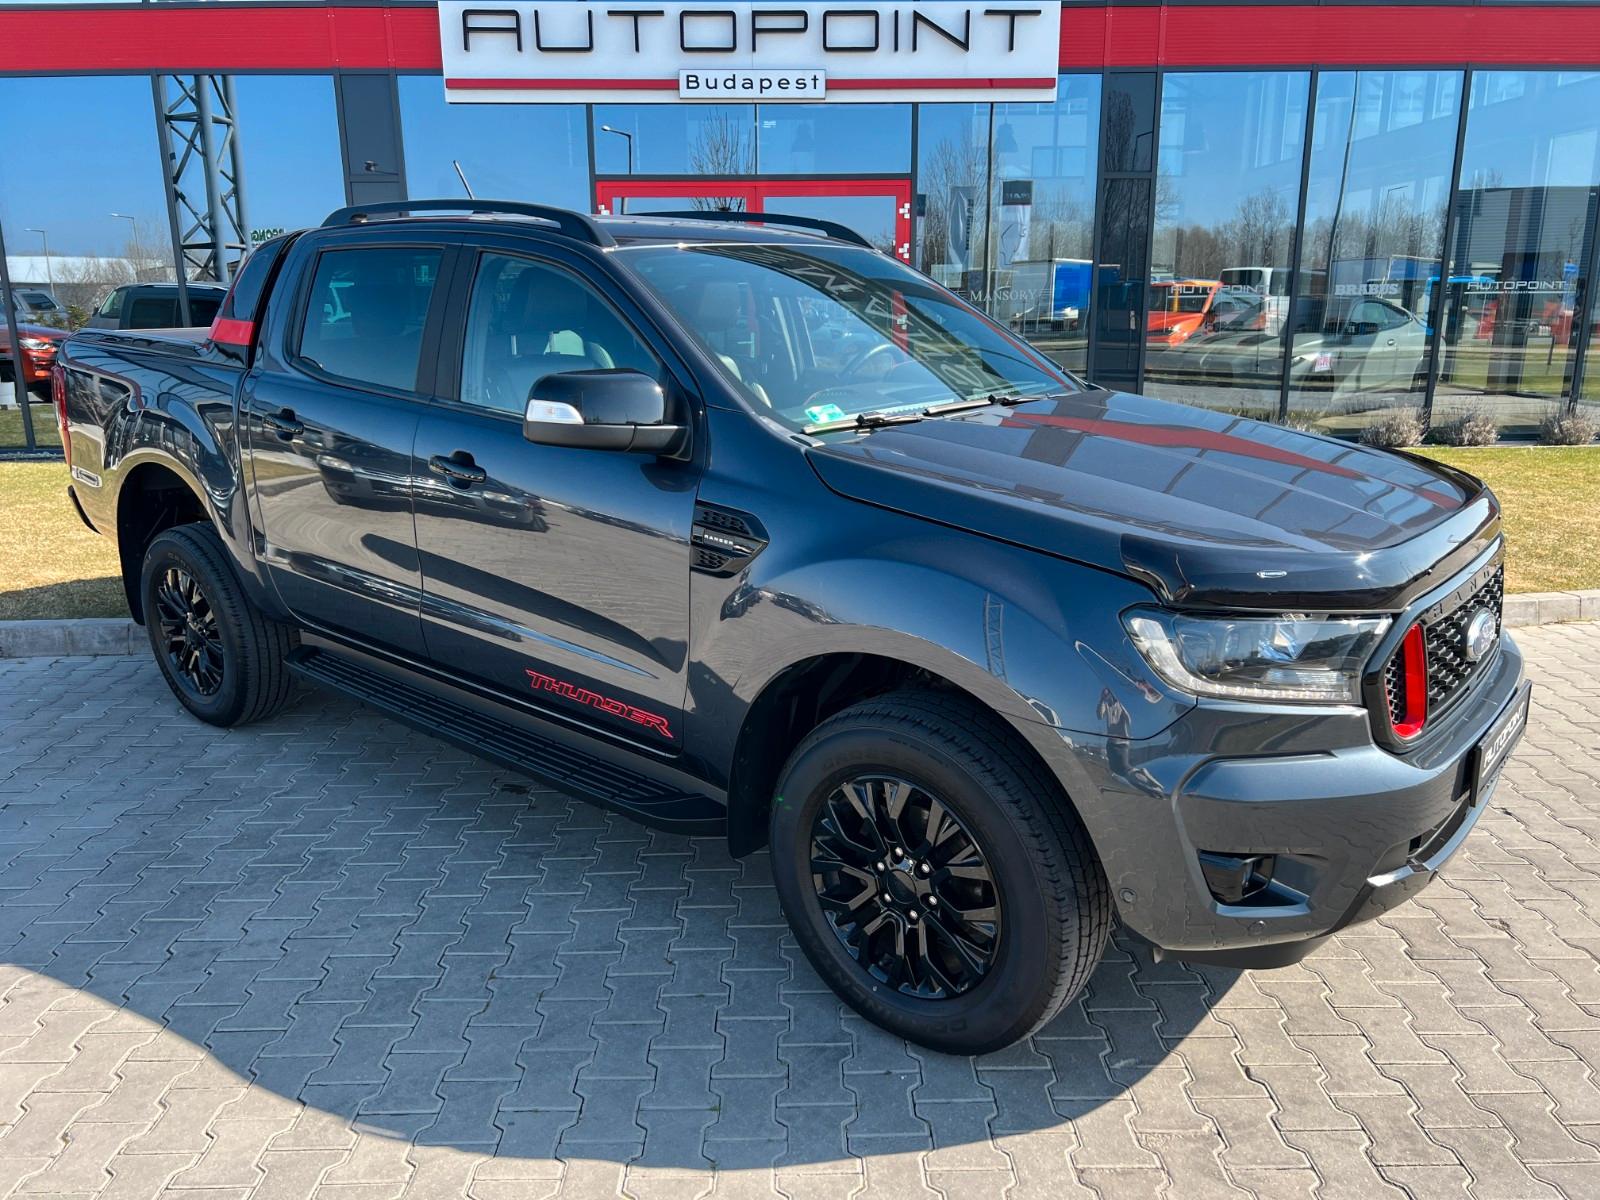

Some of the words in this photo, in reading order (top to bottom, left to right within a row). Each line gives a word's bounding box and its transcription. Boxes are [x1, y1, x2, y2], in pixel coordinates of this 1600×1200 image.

[462, 9, 1042, 53] AUTOPOINT
[686, 74, 819, 96] Budapest
[1334, 283, 1399, 296] BRABUS
[1467, 280, 1567, 290] AUTOPOINT
[970, 290, 1038, 301] MANSORY
[525, 669, 674, 739] THUNDER
